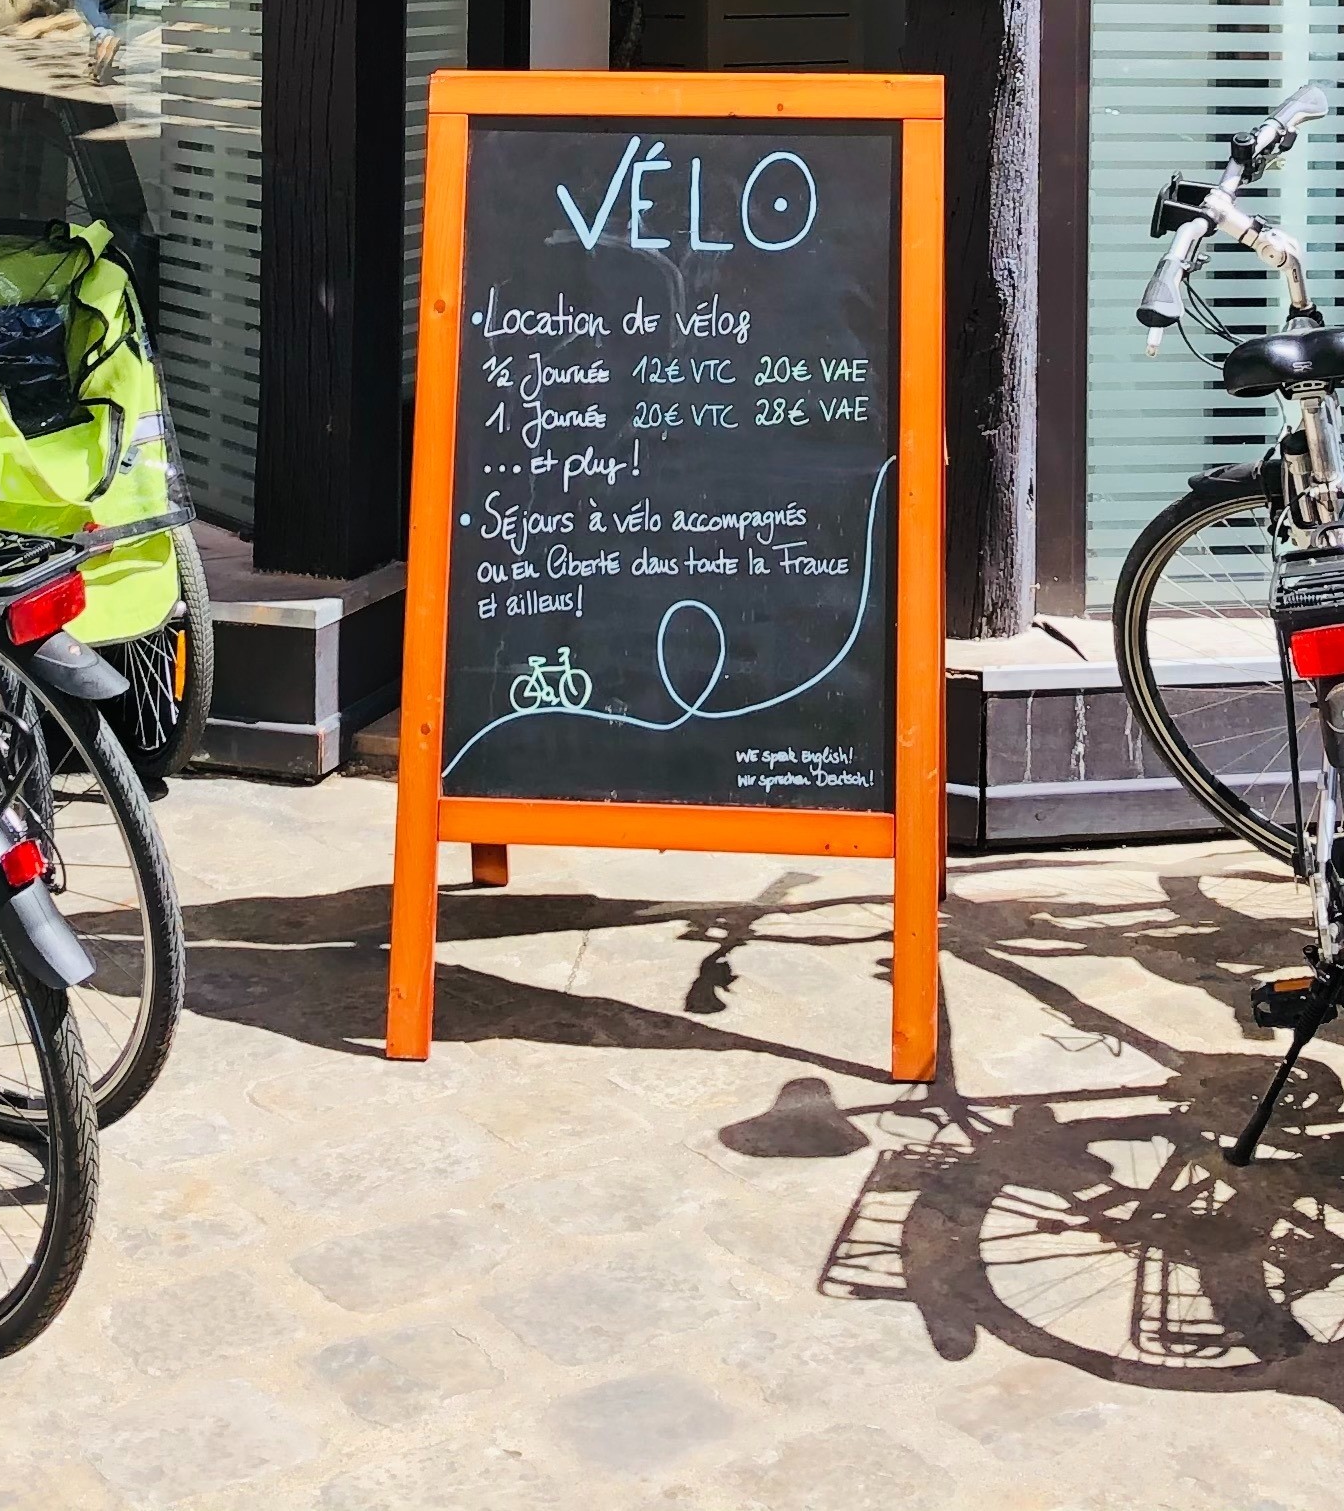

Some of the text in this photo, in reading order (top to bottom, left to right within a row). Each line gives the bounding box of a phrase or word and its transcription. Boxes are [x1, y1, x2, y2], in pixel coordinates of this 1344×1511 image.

[557, 136, 817, 252] VÉLO
[482, 288, 751, 344] Location de vélos
[520, 354, 611, 402] Journée
[632, 356, 686, 387] 12€
[692, 358, 737, 385] VTC
[754, 356, 812, 387] 20€
[819, 356, 869, 384] VAE
[523, 401, 607, 449] Journée
[632, 404, 683, 429] 20€
[692, 403, 739, 429] VTC
[755, 396, 809, 426] 28€
[818, 396, 869, 423] VAE
[480, 491, 807, 555] Séjours à vélo accompagnés
[631, 546, 680, 576] dans
[684, 546, 740, 576] toute
[749, 546, 771, 576] la
[772, 540, 850, 576] France
